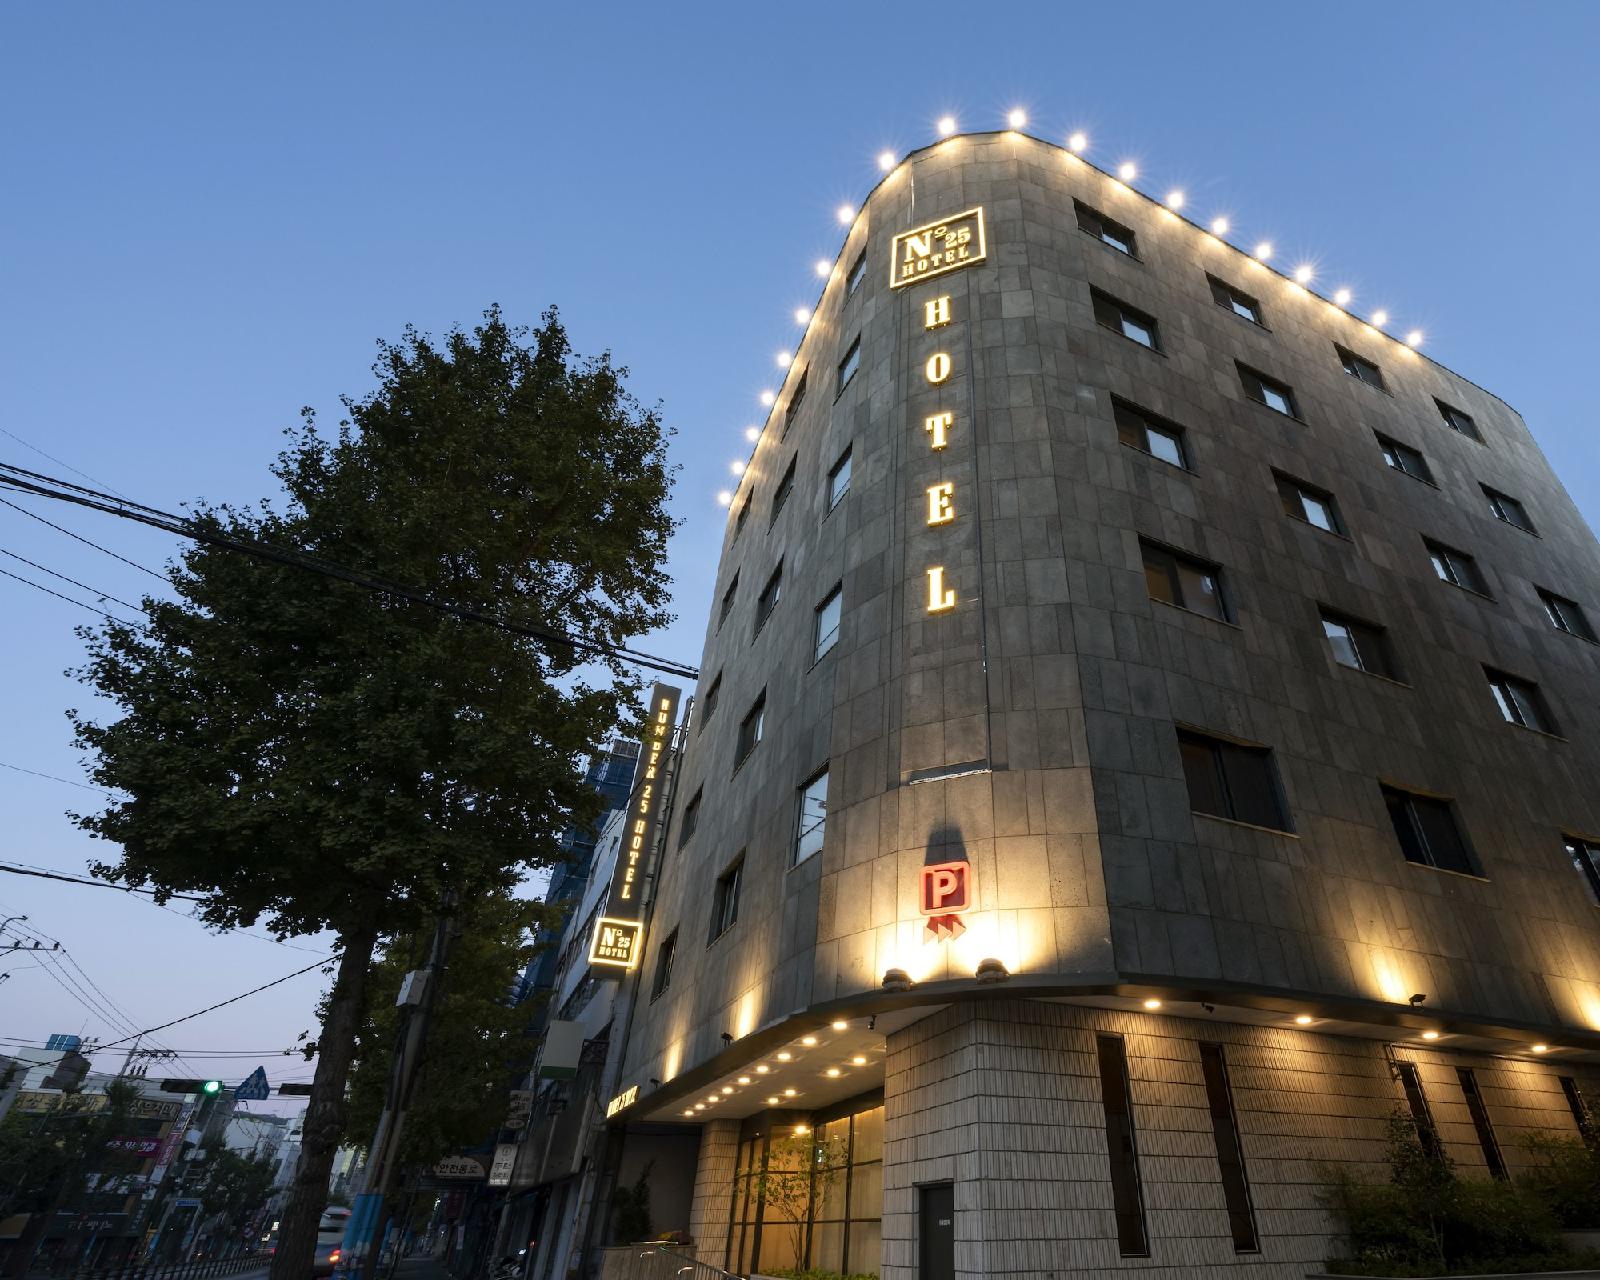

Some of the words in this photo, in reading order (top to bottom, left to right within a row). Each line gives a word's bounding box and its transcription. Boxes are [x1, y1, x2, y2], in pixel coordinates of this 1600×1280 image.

[902, 244, 969, 278] HOTEL
[924, 296, 955, 612] HOTEL
[641, 785, 652, 814] 25
[621, 820, 646, 899] HOTEL
[932, 870, 959, 909] P
[598, 945, 628, 959] HOTEL
